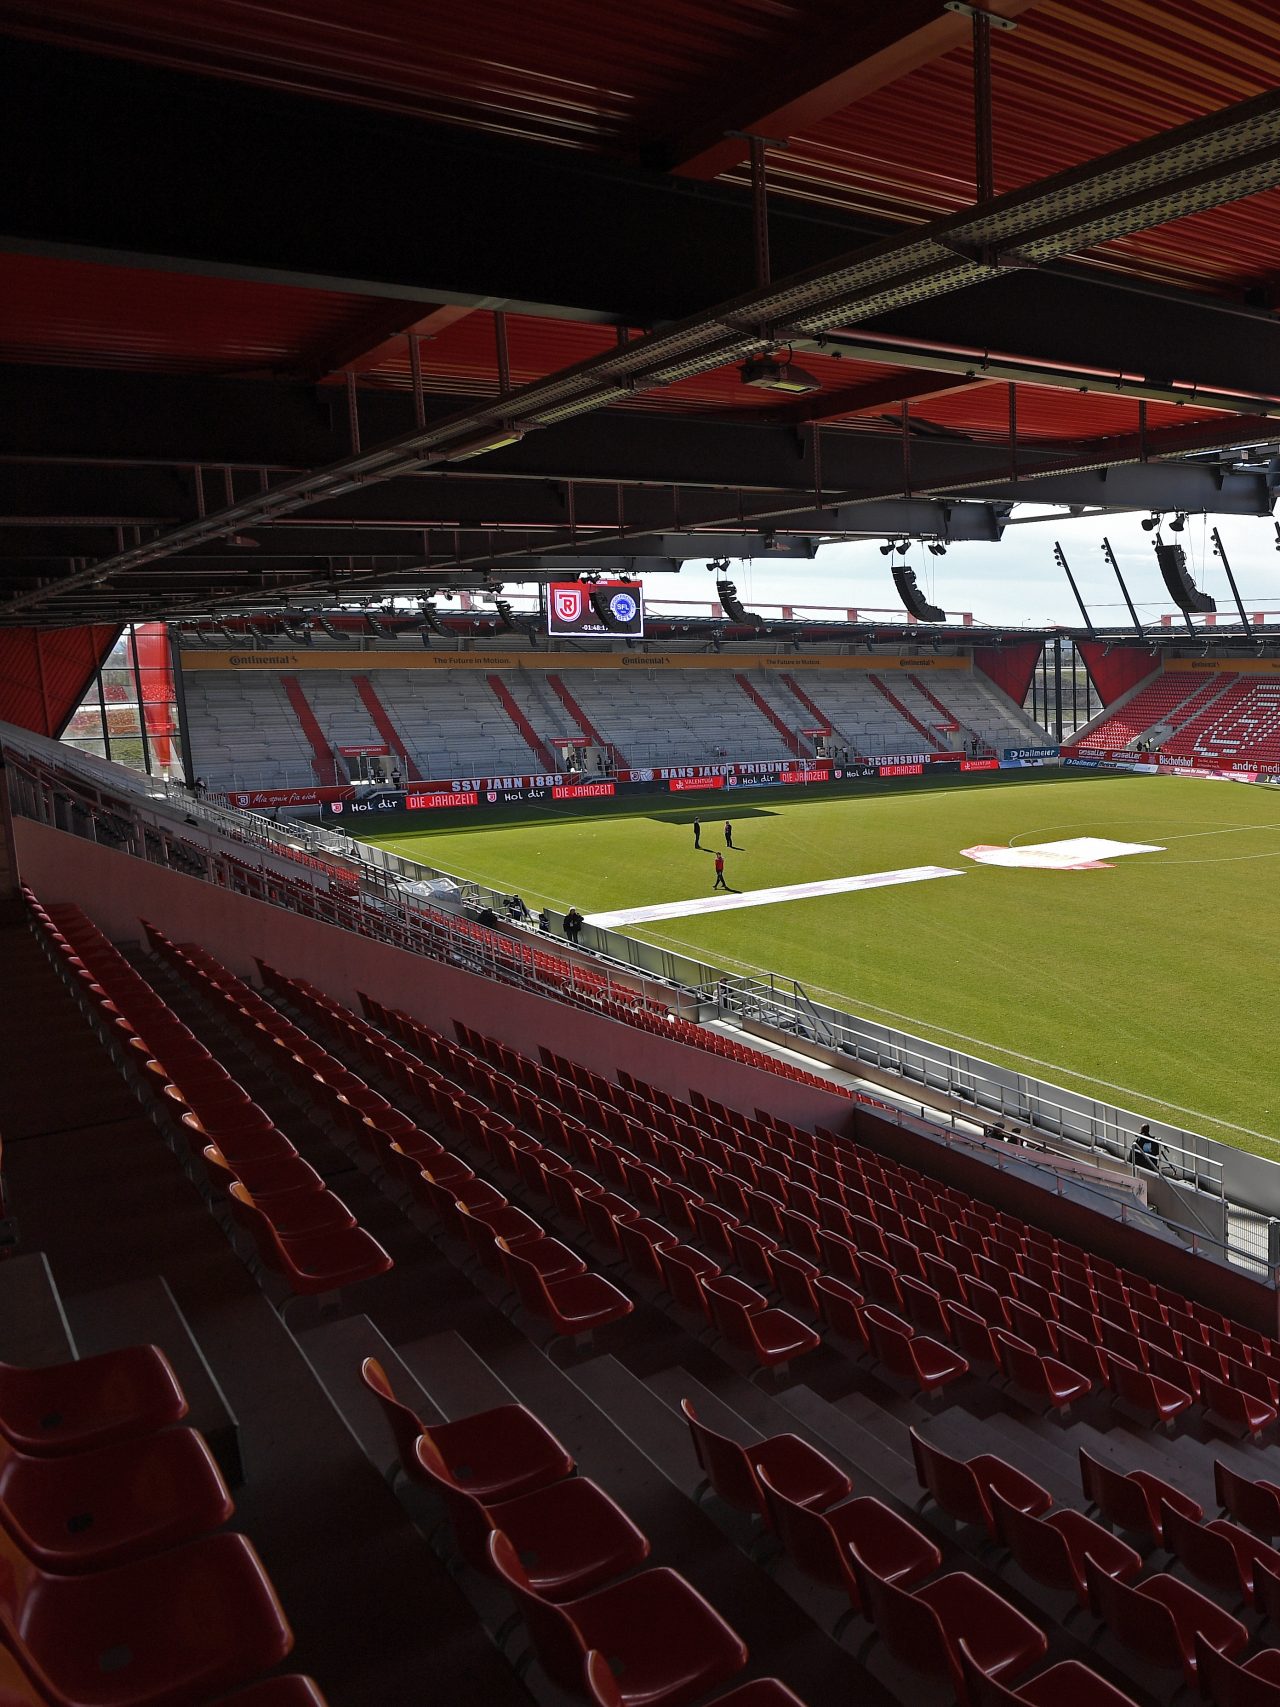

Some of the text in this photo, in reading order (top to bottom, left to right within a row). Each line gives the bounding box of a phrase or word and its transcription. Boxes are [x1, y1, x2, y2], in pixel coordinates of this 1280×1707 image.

[229, 655, 290, 665] Continental
[621, 656, 664, 665] Continental
[1019, 749, 1055, 758] Dallmeier
[867, 754, 931, 766] REGENSBURG
[1071, 759, 1097, 767] Dallmeier
[1159, 754, 1194, 767] Bischofshof
[862, 768, 875, 776] dir
[881, 765, 921, 776] DIE JAHNZEIT
[1232, 761, 1258, 772] andré
[661, 767, 694, 779] HANS
[782, 772, 795, 783] DIE
[451, 775, 563, 792] SSV JAHN 1889
[742, 774, 774, 785] Hol dir
[504, 789, 545, 801] Hol dir
[555, 784, 613, 798] DIE JAHNZEIT
[351, 799, 398, 813] Hol dir
[410, 792, 475, 809] DIE JAHNZEIT
